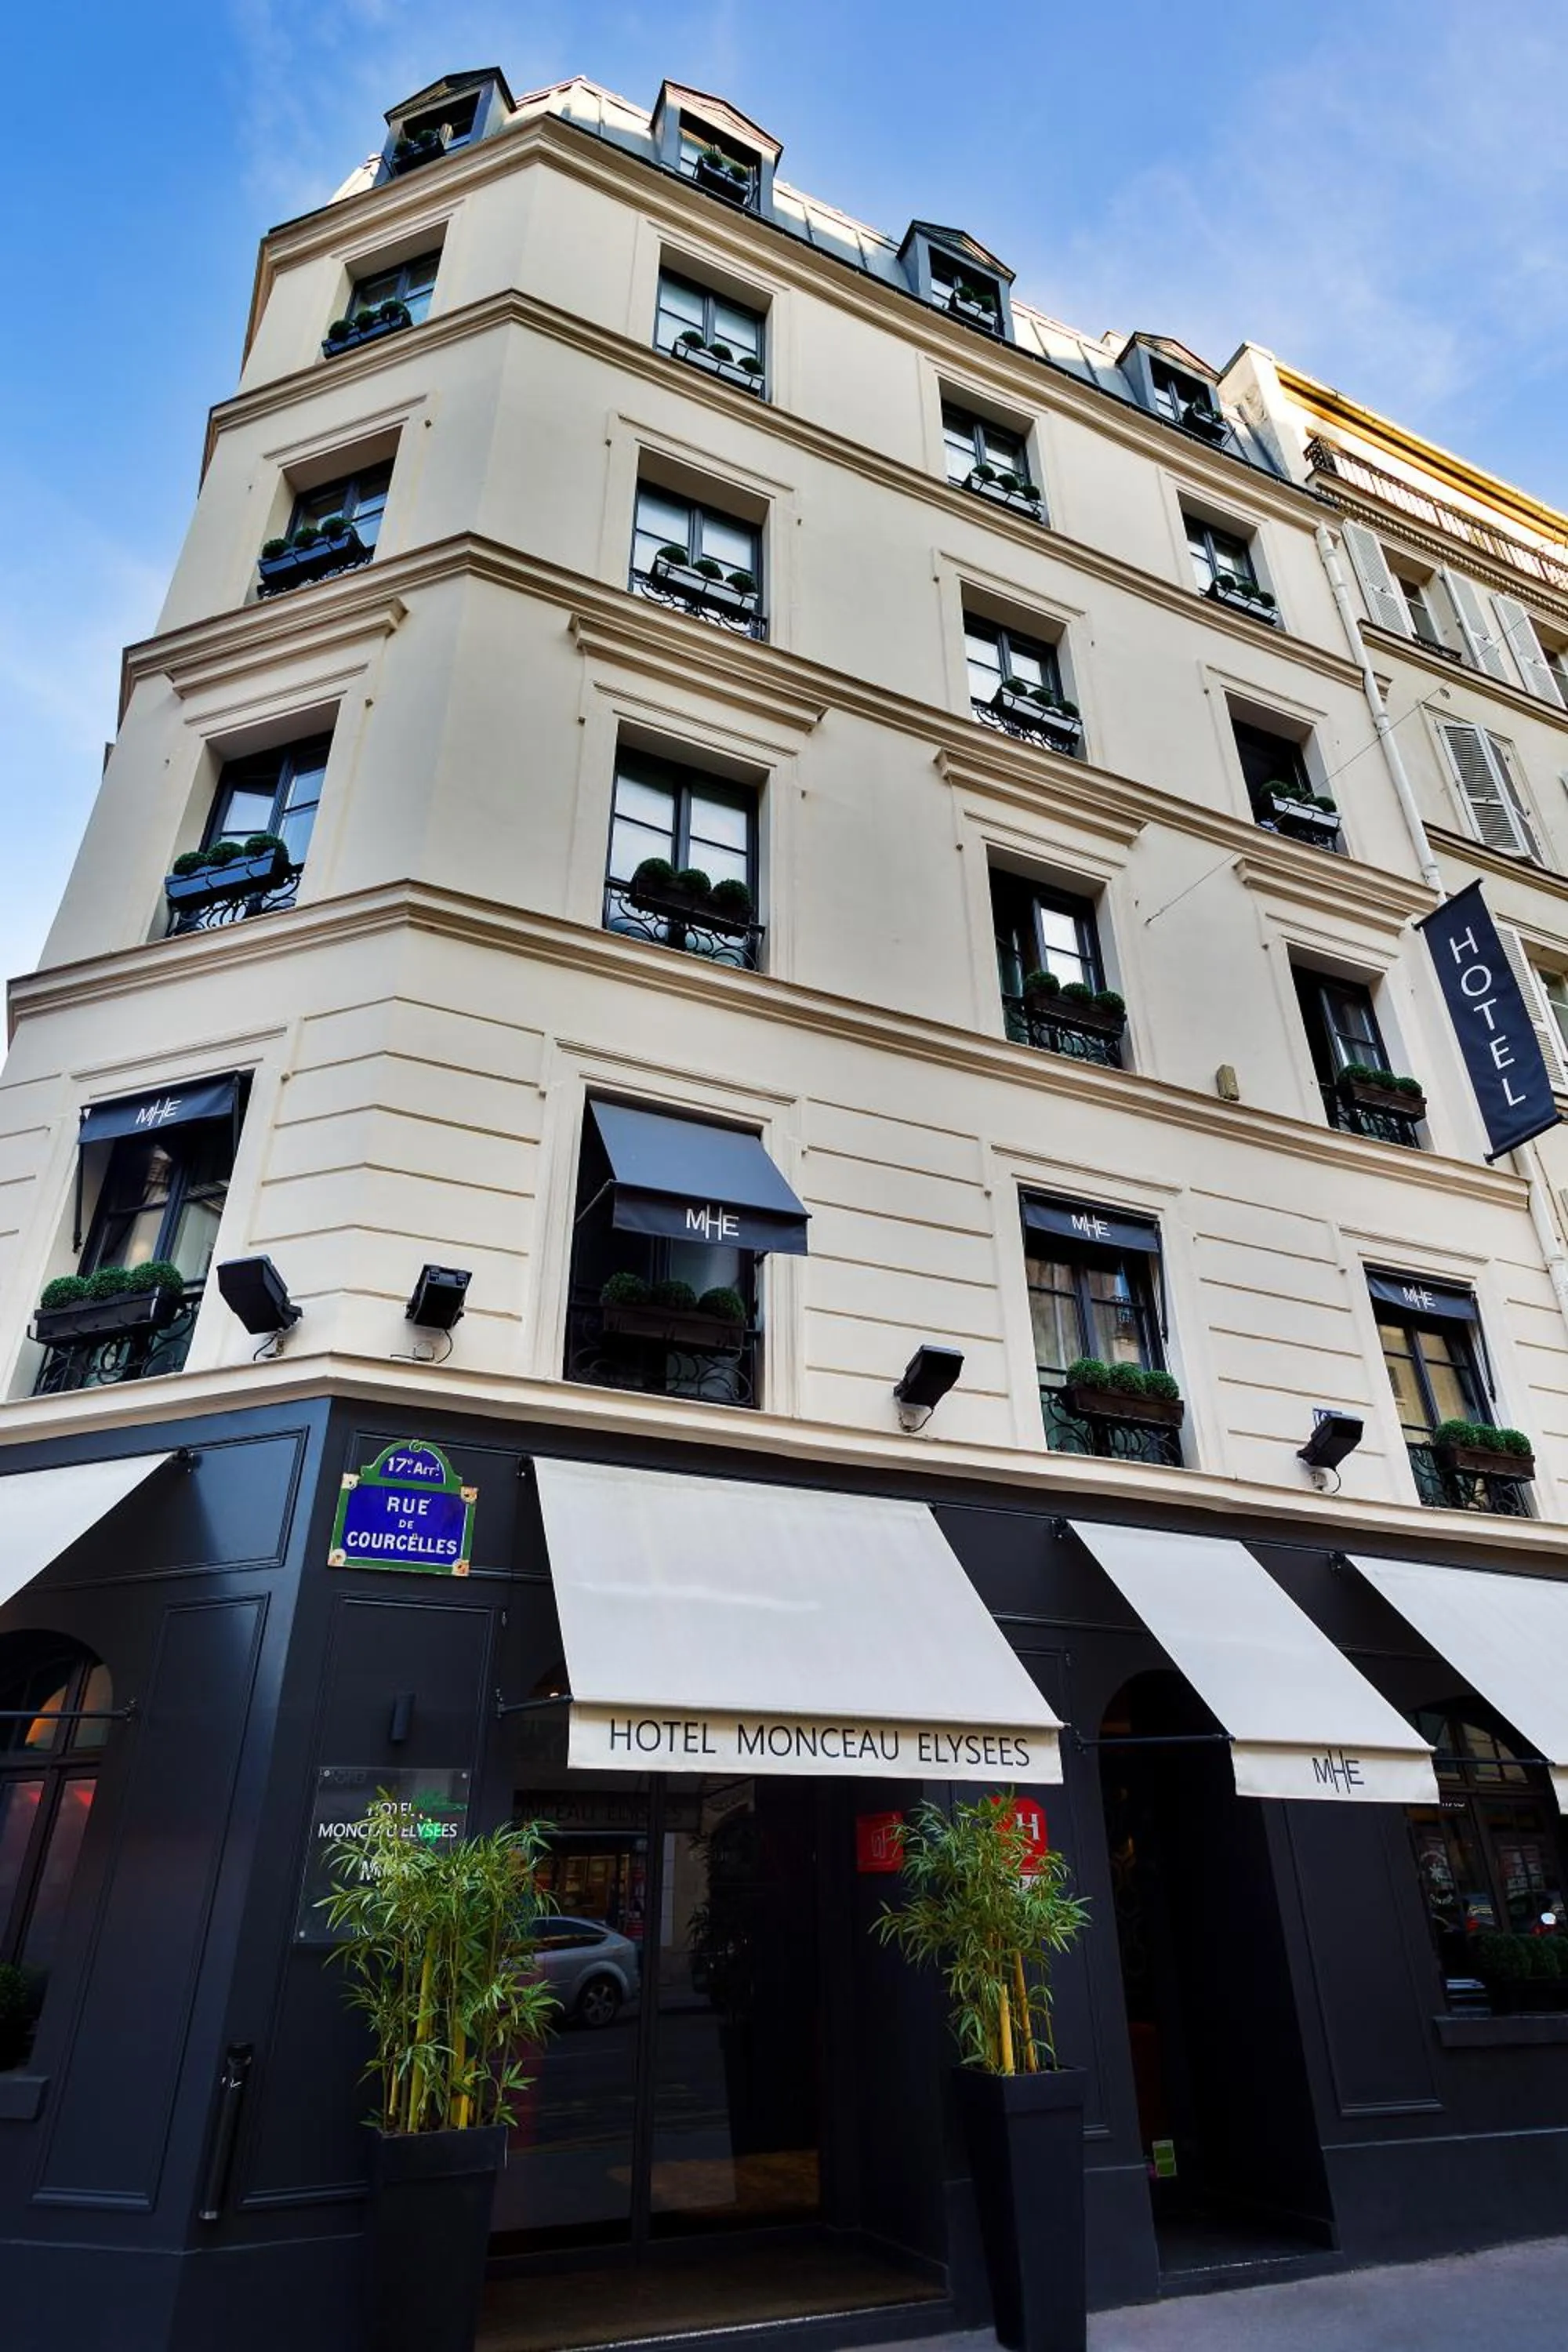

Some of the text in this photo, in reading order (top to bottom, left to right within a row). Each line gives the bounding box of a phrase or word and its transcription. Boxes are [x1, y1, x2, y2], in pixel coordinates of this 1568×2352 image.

[1450, 927, 1526, 1106] HOTEL
[136, 1097, 182, 1127] MHE
[686, 1204, 739, 1240] MHE
[1070, 1213, 1111, 1239] MHE
[1402, 1284, 1436, 1309] MHE
[387, 1497, 430, 1515] RUE
[397, 1519, 415, 1529] DE
[347, 1531, 457, 1555] COURCELLES
[611, 1719, 1029, 1766] HOTEL MONCEAU ELYSEES
[1312, 1749, 1364, 1794] MHE
[401, 1824, 458, 1838] ELYSEES
